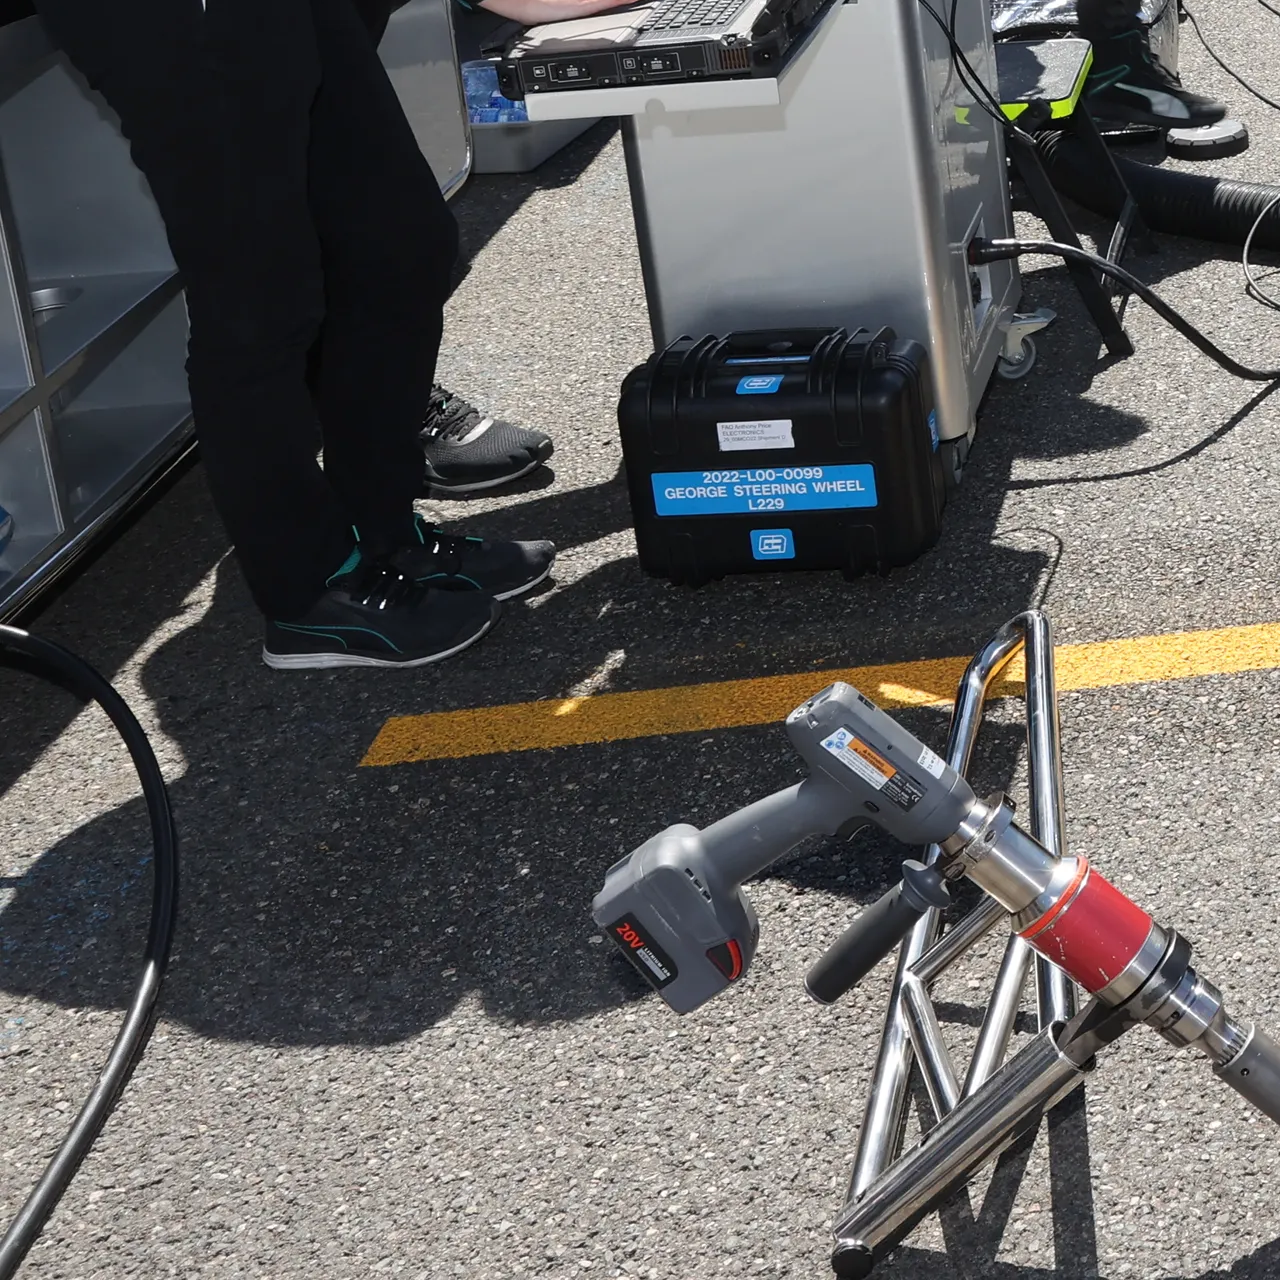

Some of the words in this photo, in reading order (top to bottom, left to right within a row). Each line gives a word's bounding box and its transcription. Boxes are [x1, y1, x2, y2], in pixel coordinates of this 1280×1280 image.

[734, 423, 757, 431] Anthony
[664, 487, 728, 500] GEORGE
[733, 483, 807, 497] STEERING
[812, 480, 865, 493] WHEEL
[748, 498, 785, 511] L229
[615, 922, 645, 949] 20V
[644, 947, 663, 968] LITHIUM
